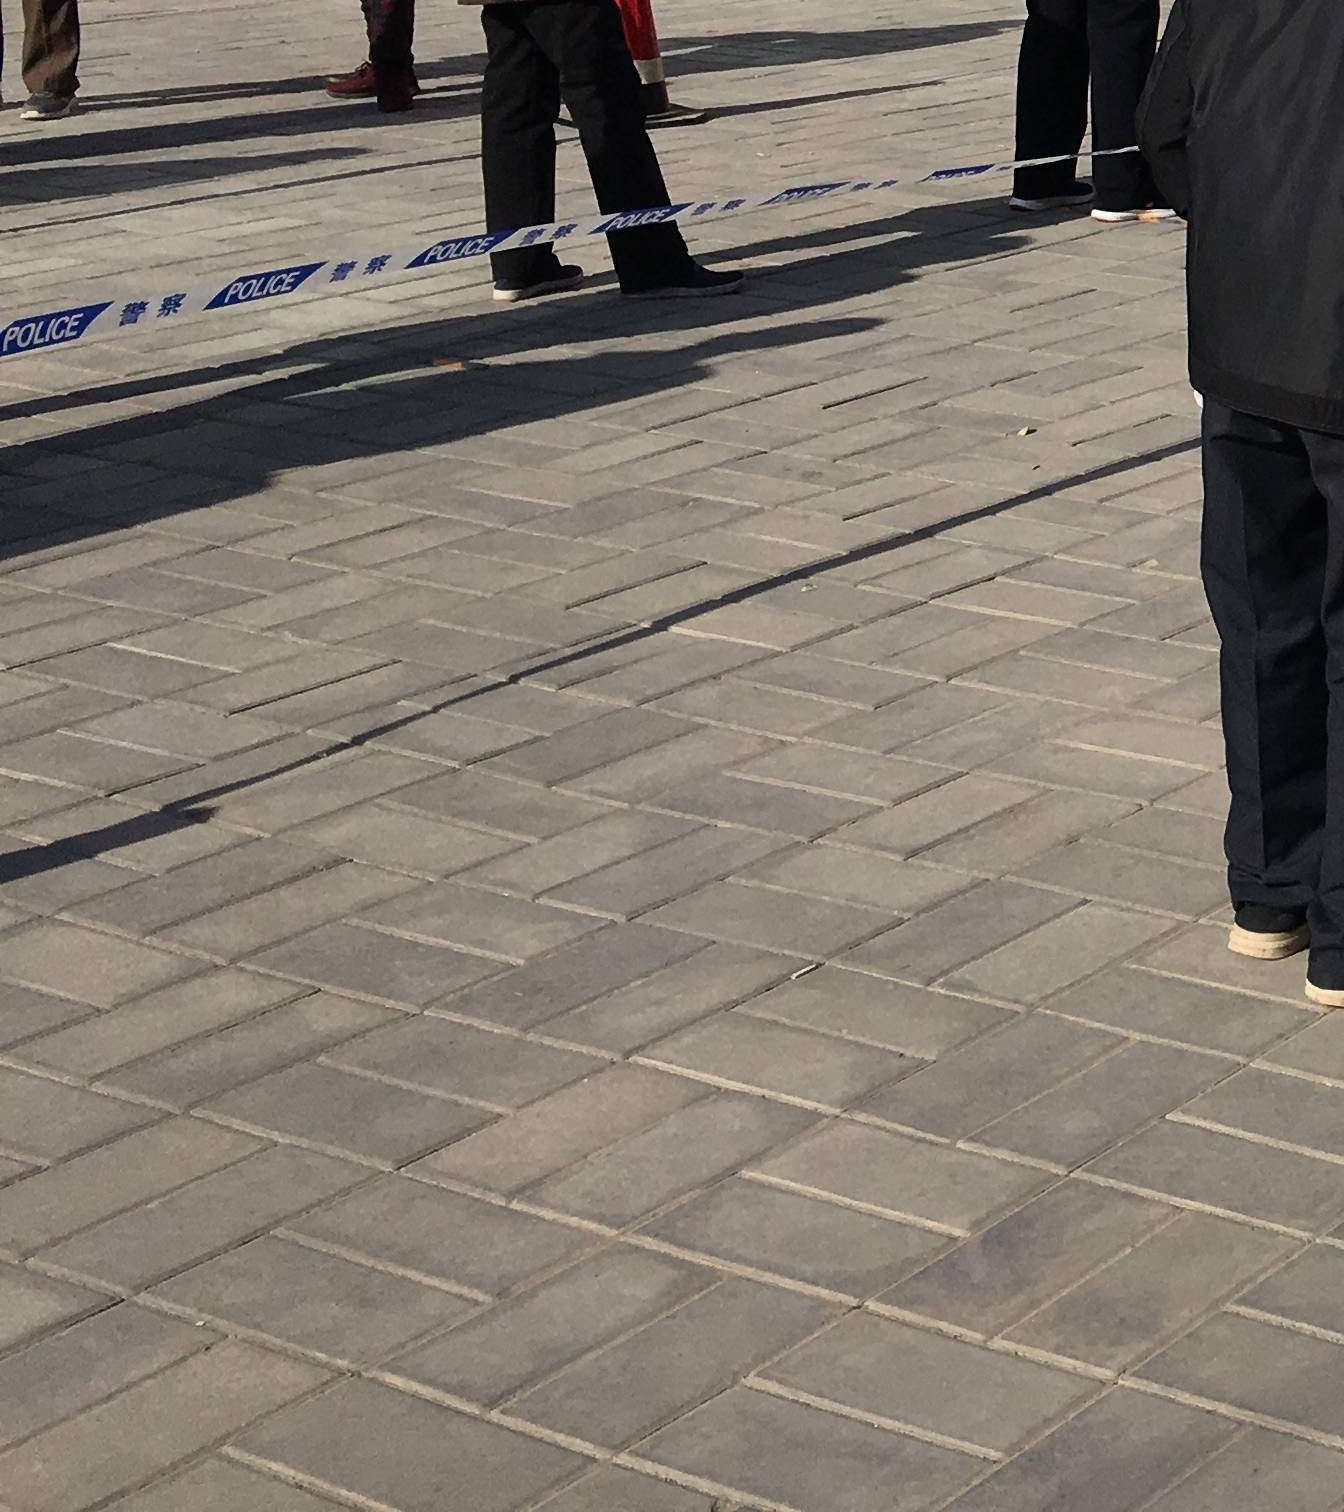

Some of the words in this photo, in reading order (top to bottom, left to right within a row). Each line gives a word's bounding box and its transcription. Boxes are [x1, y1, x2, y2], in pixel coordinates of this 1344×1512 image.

[2, 313, 84, 352] POLICE
[224, 271, 301, 303] POLICE
[423, 237, 495, 264] POLICE
[605, 208, 671, 232] POLICE
